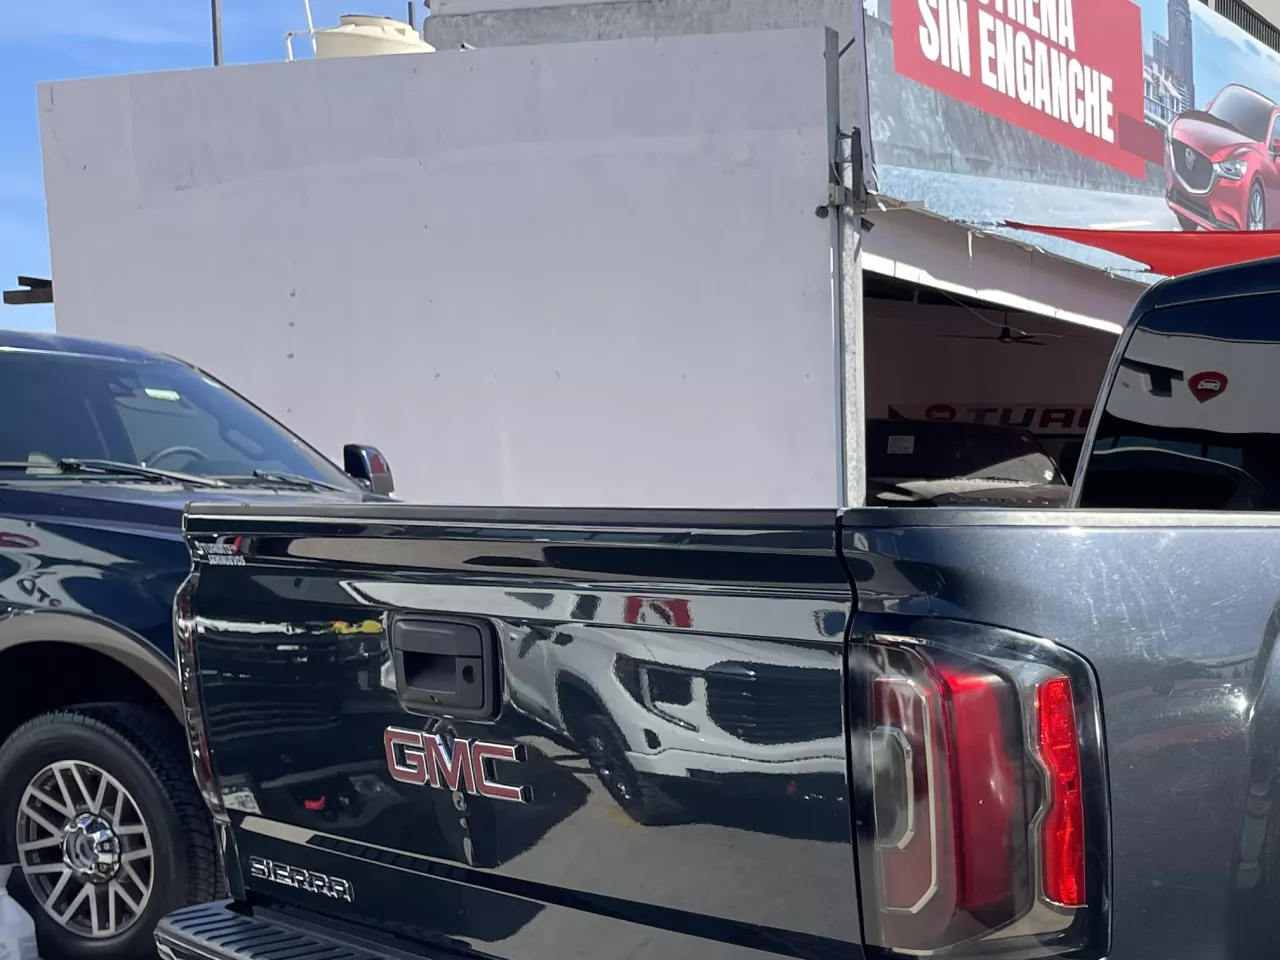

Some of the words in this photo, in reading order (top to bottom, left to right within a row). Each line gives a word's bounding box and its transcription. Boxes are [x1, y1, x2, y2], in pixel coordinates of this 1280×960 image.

[917, 0, 971, 78] SIN
[978, 8, 1114, 144] ENGANCHE
[384, 725, 532, 804] GMC
[249, 855, 355, 902] SIERRA
